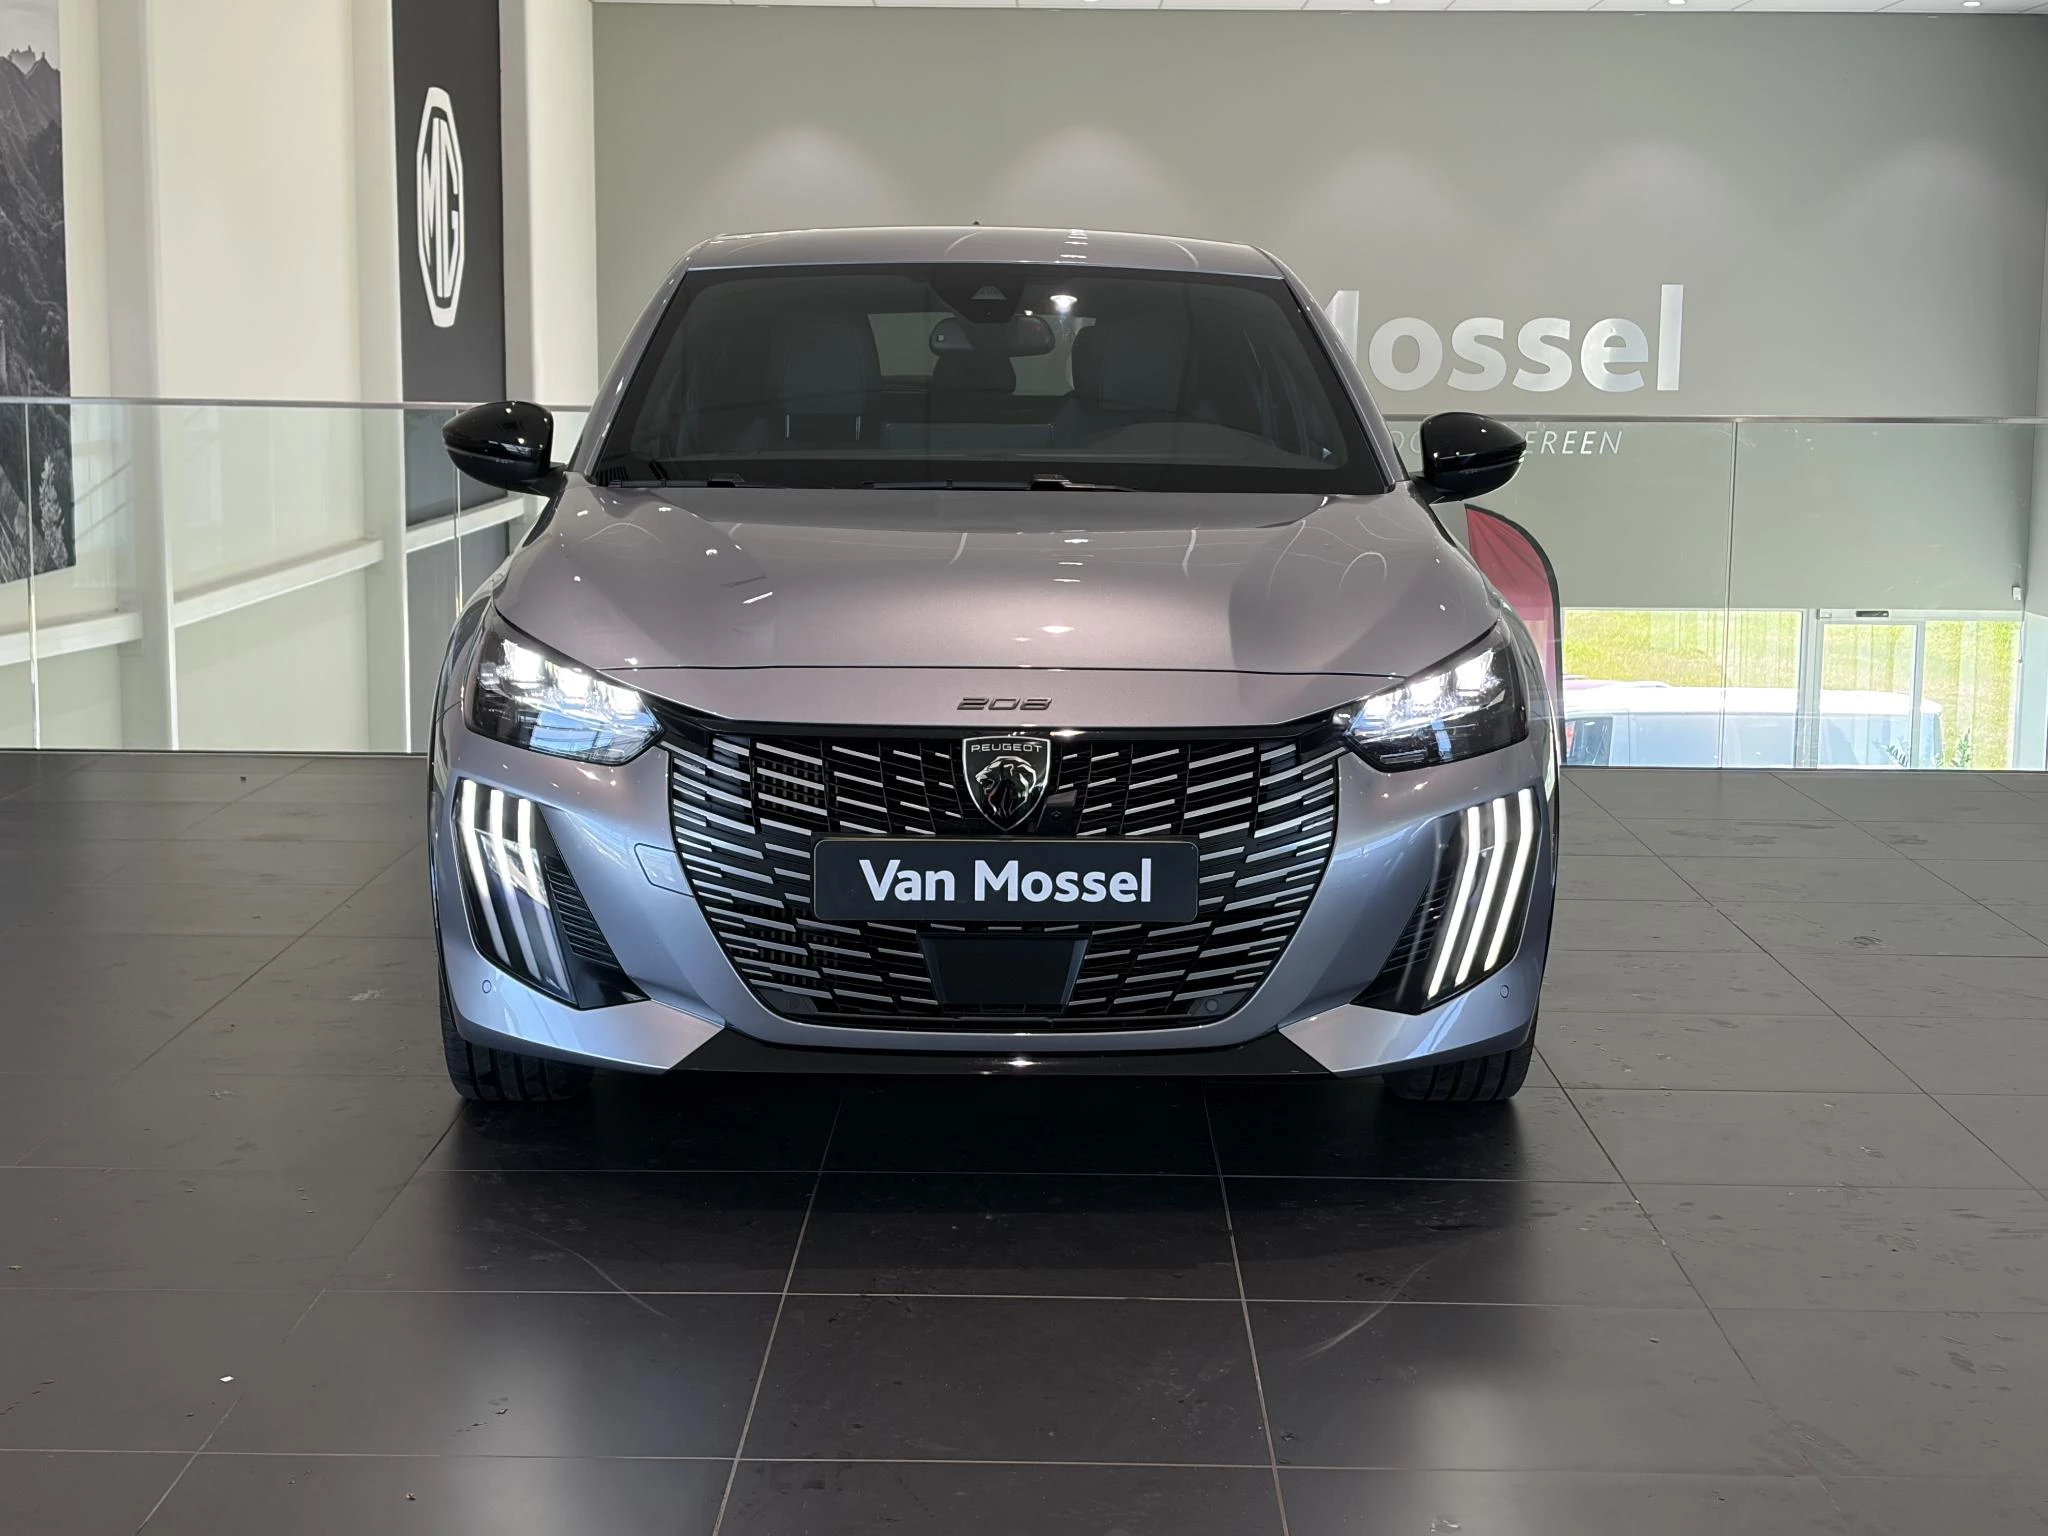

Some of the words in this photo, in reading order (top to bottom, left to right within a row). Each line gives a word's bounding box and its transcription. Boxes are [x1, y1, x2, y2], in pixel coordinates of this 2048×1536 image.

[421, 116, 460, 299] MG
[1524, 430, 1623, 455] EREEN
[956, 697, 1053, 711] 208
[970, 742, 1043, 753] PEUGEOT
[858, 858, 956, 903] Van
[973, 857, 1152, 903] Mossel
